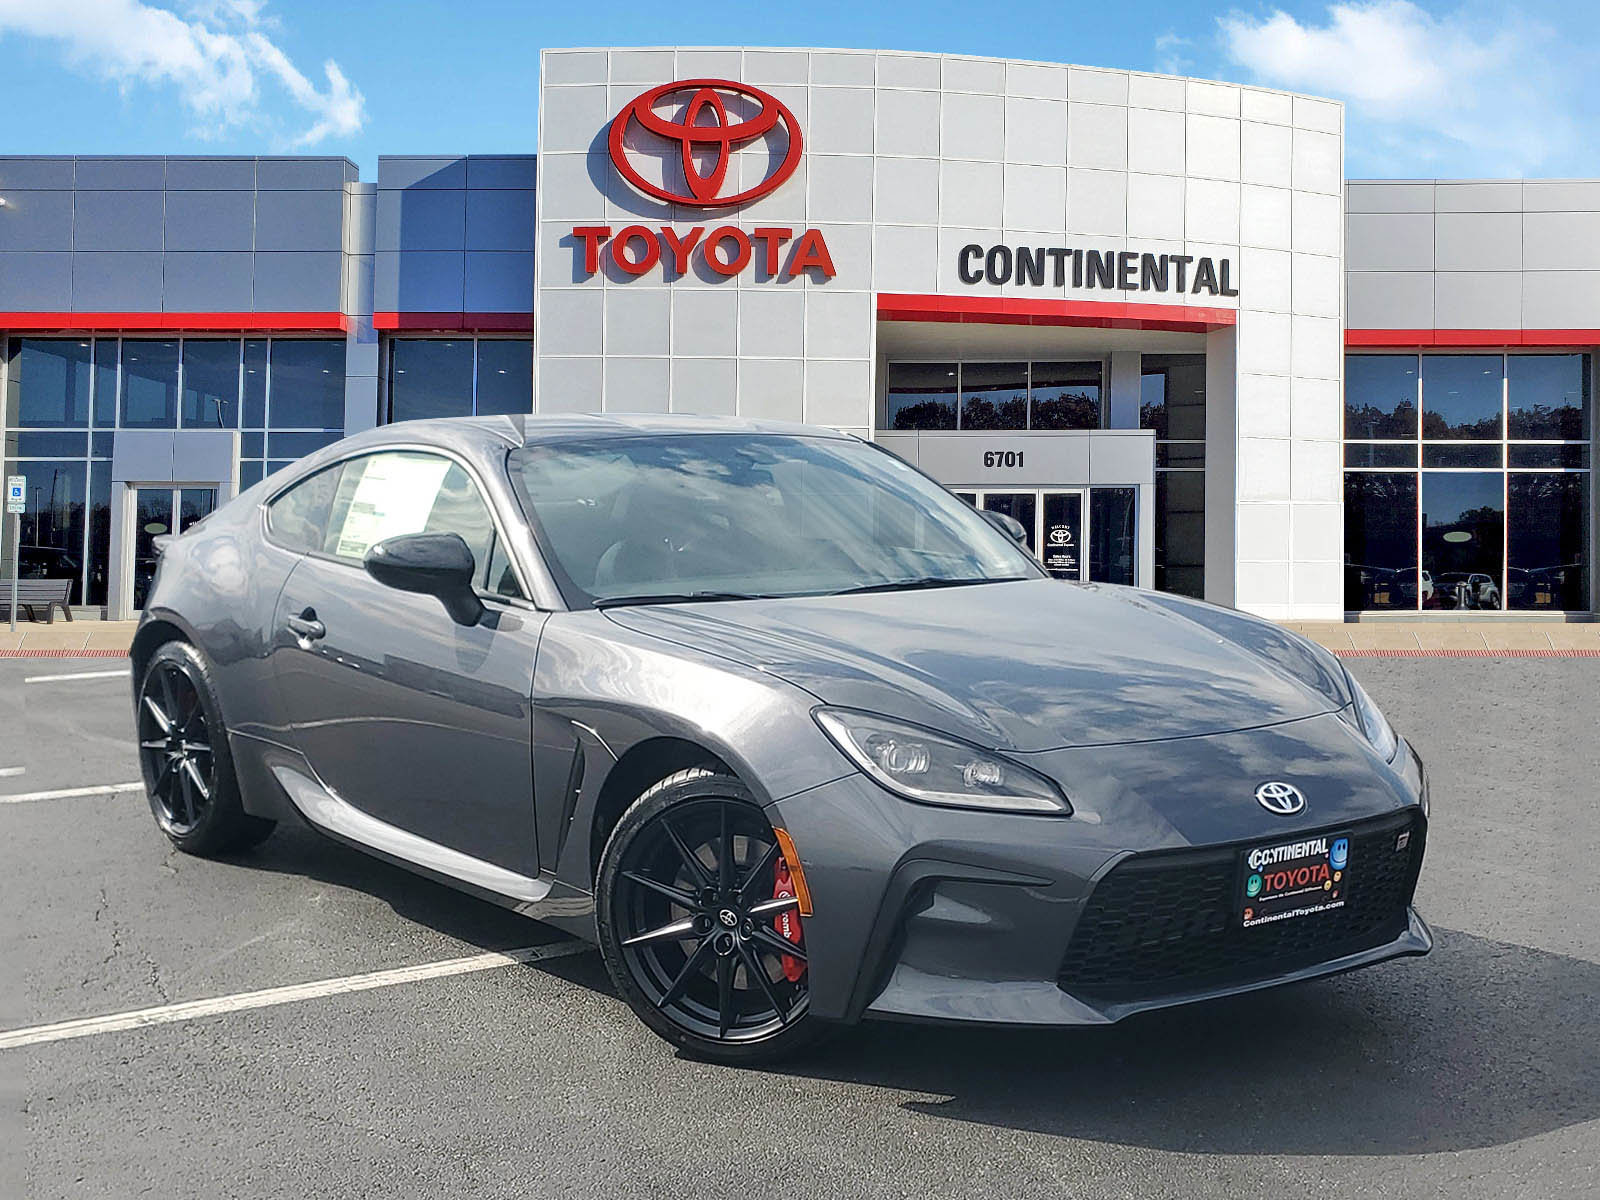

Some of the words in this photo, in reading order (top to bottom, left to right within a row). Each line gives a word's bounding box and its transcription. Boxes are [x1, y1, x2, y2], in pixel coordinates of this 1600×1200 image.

[572, 225, 837, 277] TOYOTA
[958, 244, 1239, 297] CONTINENTAL
[983, 451, 1024, 468] 6701
[1248, 837, 1329, 869] CONTINENTAL
[1263, 863, 1330, 892] TOYOTA
[1243, 900, 1345, 928] ContinentalToyota.com
